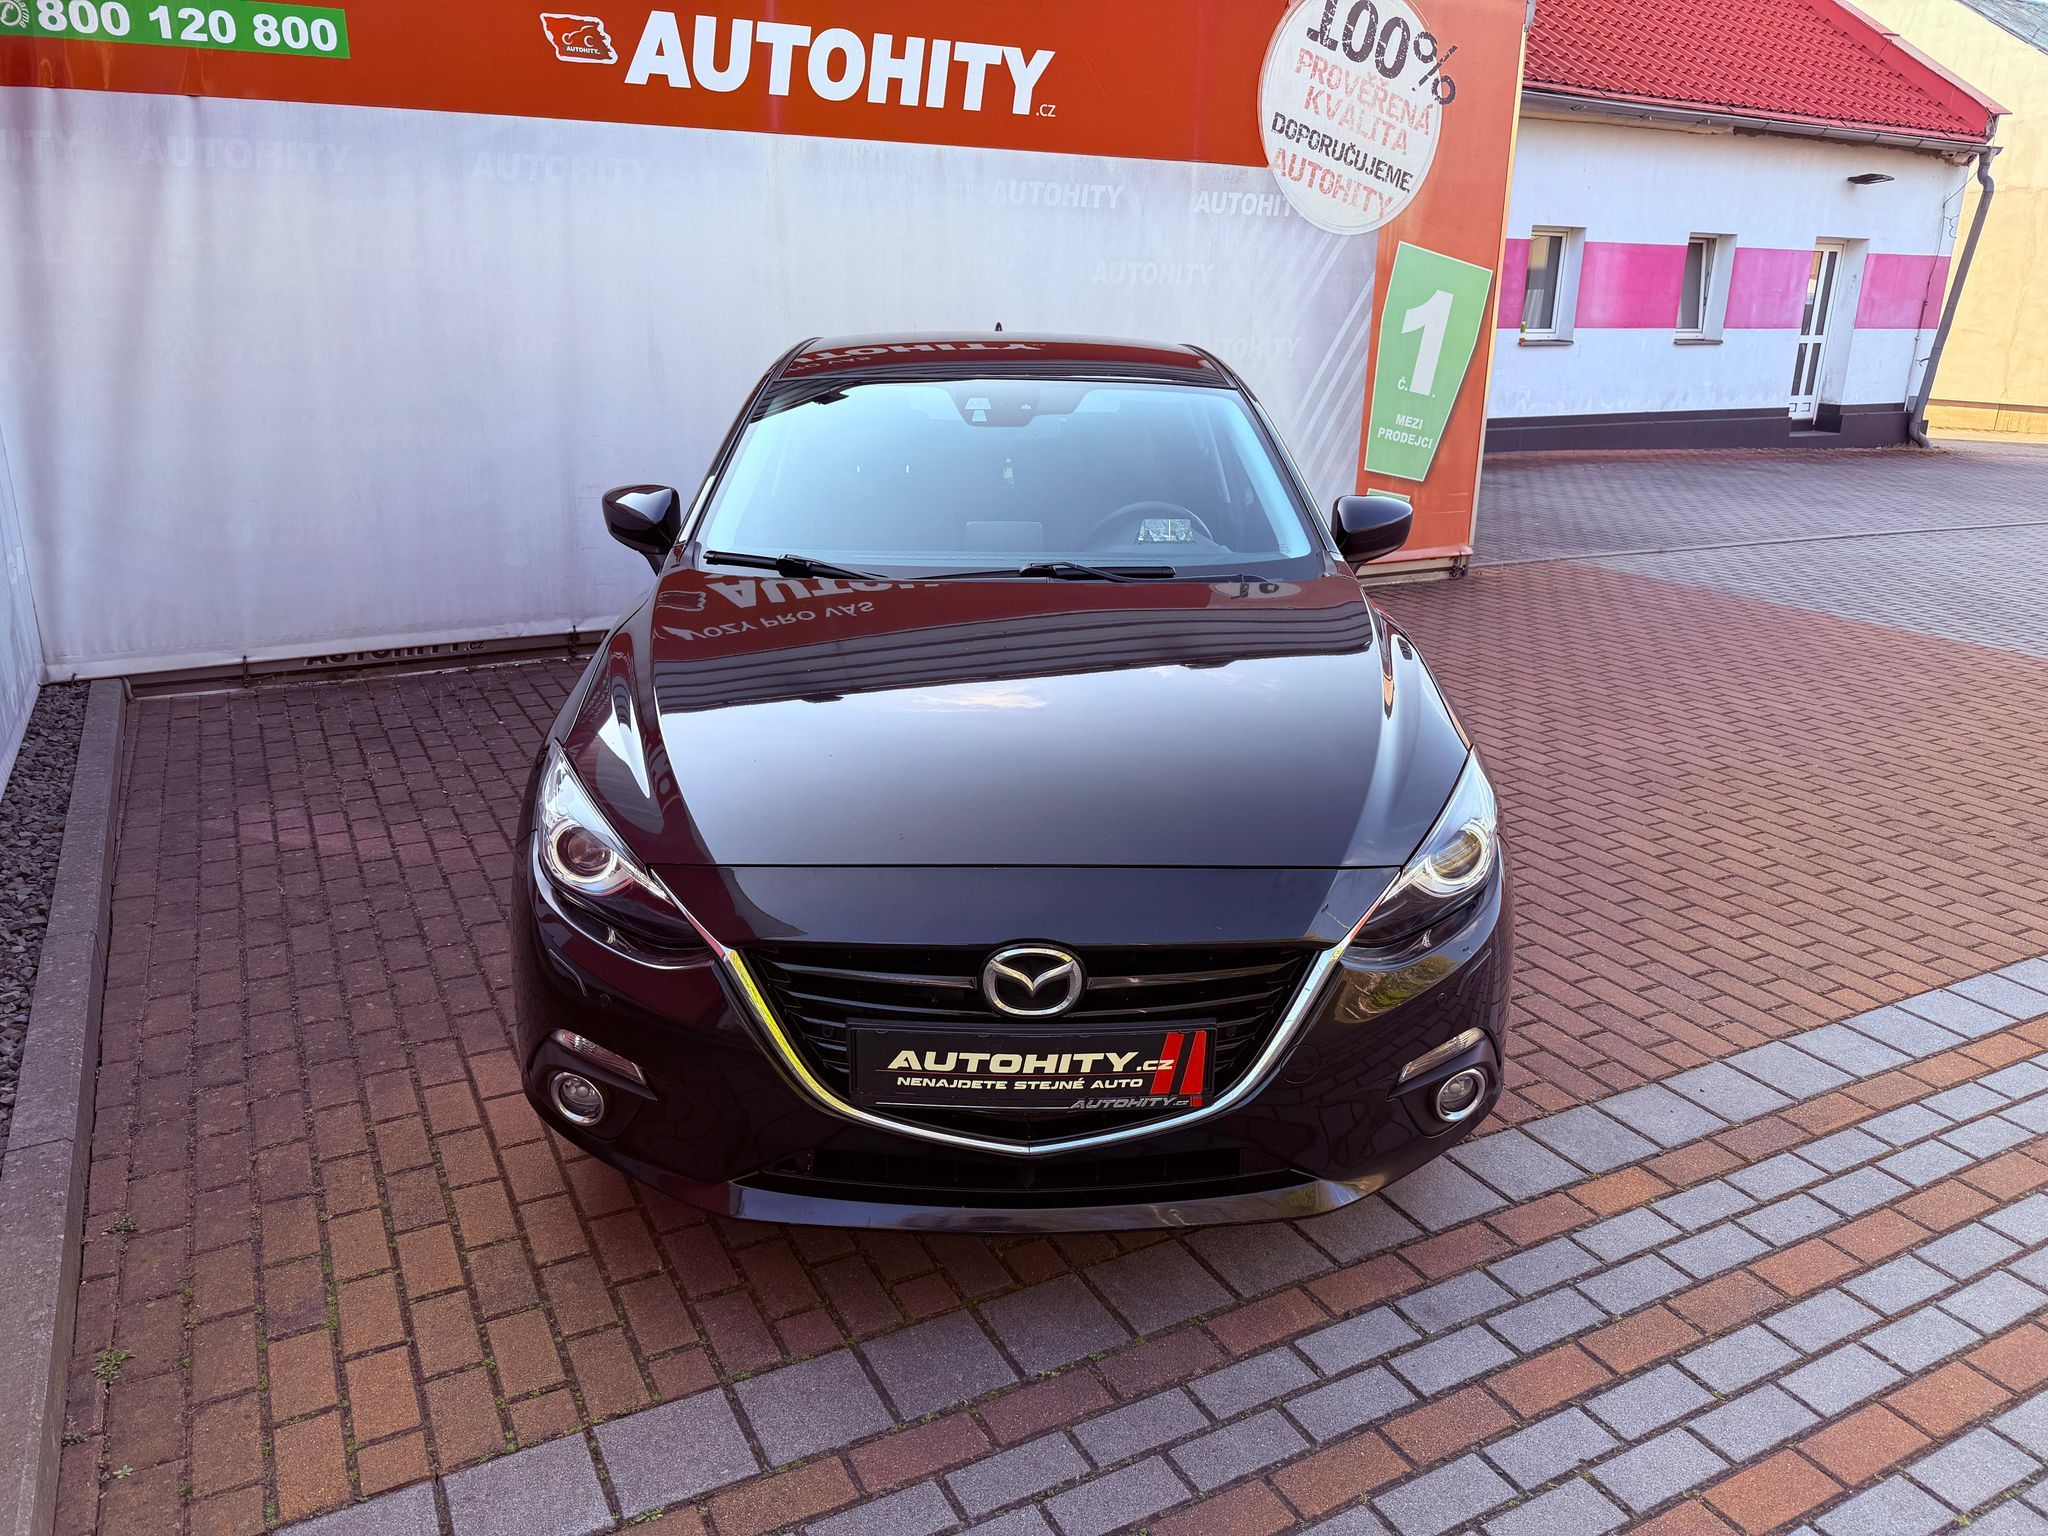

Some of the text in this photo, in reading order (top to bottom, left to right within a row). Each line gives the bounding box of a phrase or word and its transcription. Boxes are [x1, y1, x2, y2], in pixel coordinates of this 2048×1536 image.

[37, 0, 338, 52] 800 120 800
[1306, 0, 1457, 105] 100%
[1303, 85, 1408, 156] KVALITA
[1271, 111, 1414, 193] DOPORUČUJEME
[987, 180, 1124, 209] AUTOHITY
[1270, 147, 1394, 219] AUTOHITY
[1194, 190, 1298, 217] AUTOHIT
[1377, 427, 1433, 449] PRODEJCI
[1395, 414, 1424, 430] MEZI
[896, 1077, 1143, 1090] NENAJDETE STEJNÉ AUTO
